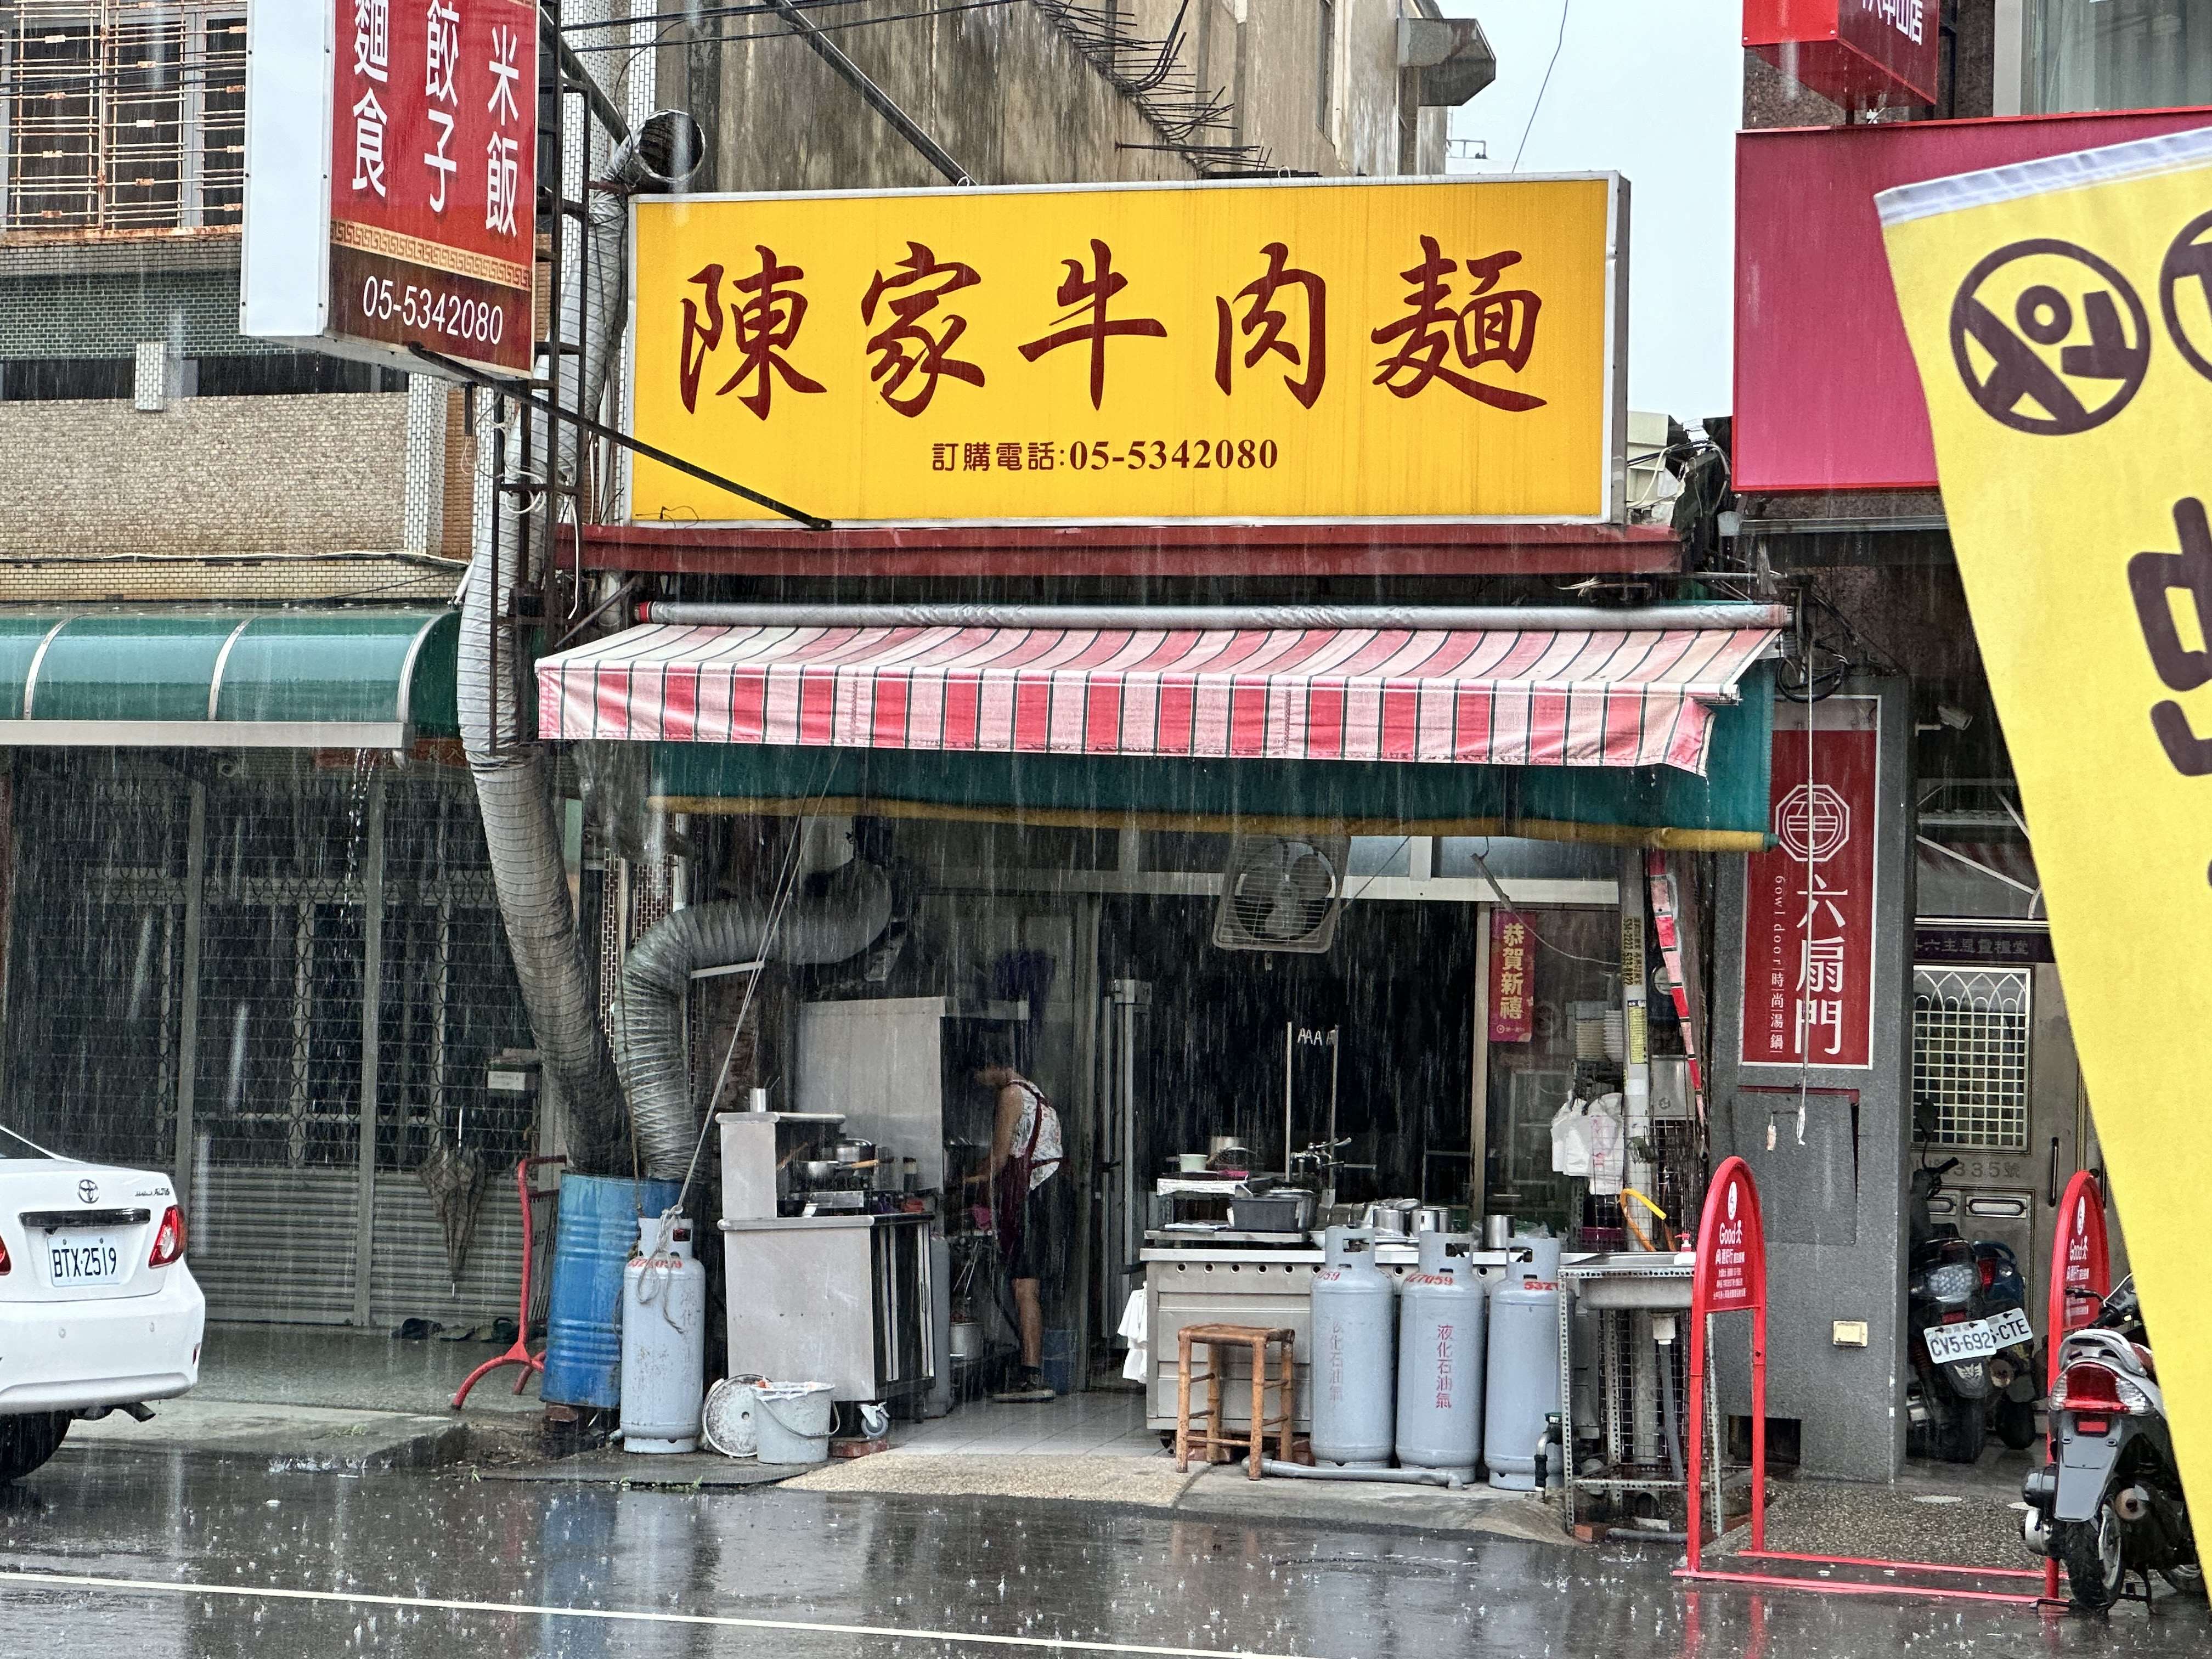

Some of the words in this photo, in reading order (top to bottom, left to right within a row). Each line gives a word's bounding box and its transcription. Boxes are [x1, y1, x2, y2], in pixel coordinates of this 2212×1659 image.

[352, 0, 388, 198] 麵食
[424, 0, 460, 212] 餃子
[486, 25, 519, 237] 米飯
[363, 275, 503, 345] 05-5342080
[679, 234, 1548, 421] 陳家牛肉麵
[1500, 923, 1525, 1019] 恭賀新禧
[1770, 972, 1784, 1049] 時尚湯鍋
[1795, 874, 1848, 1055] 六扇門
[1436, 1325, 1454, 1409] 液化石油氣
